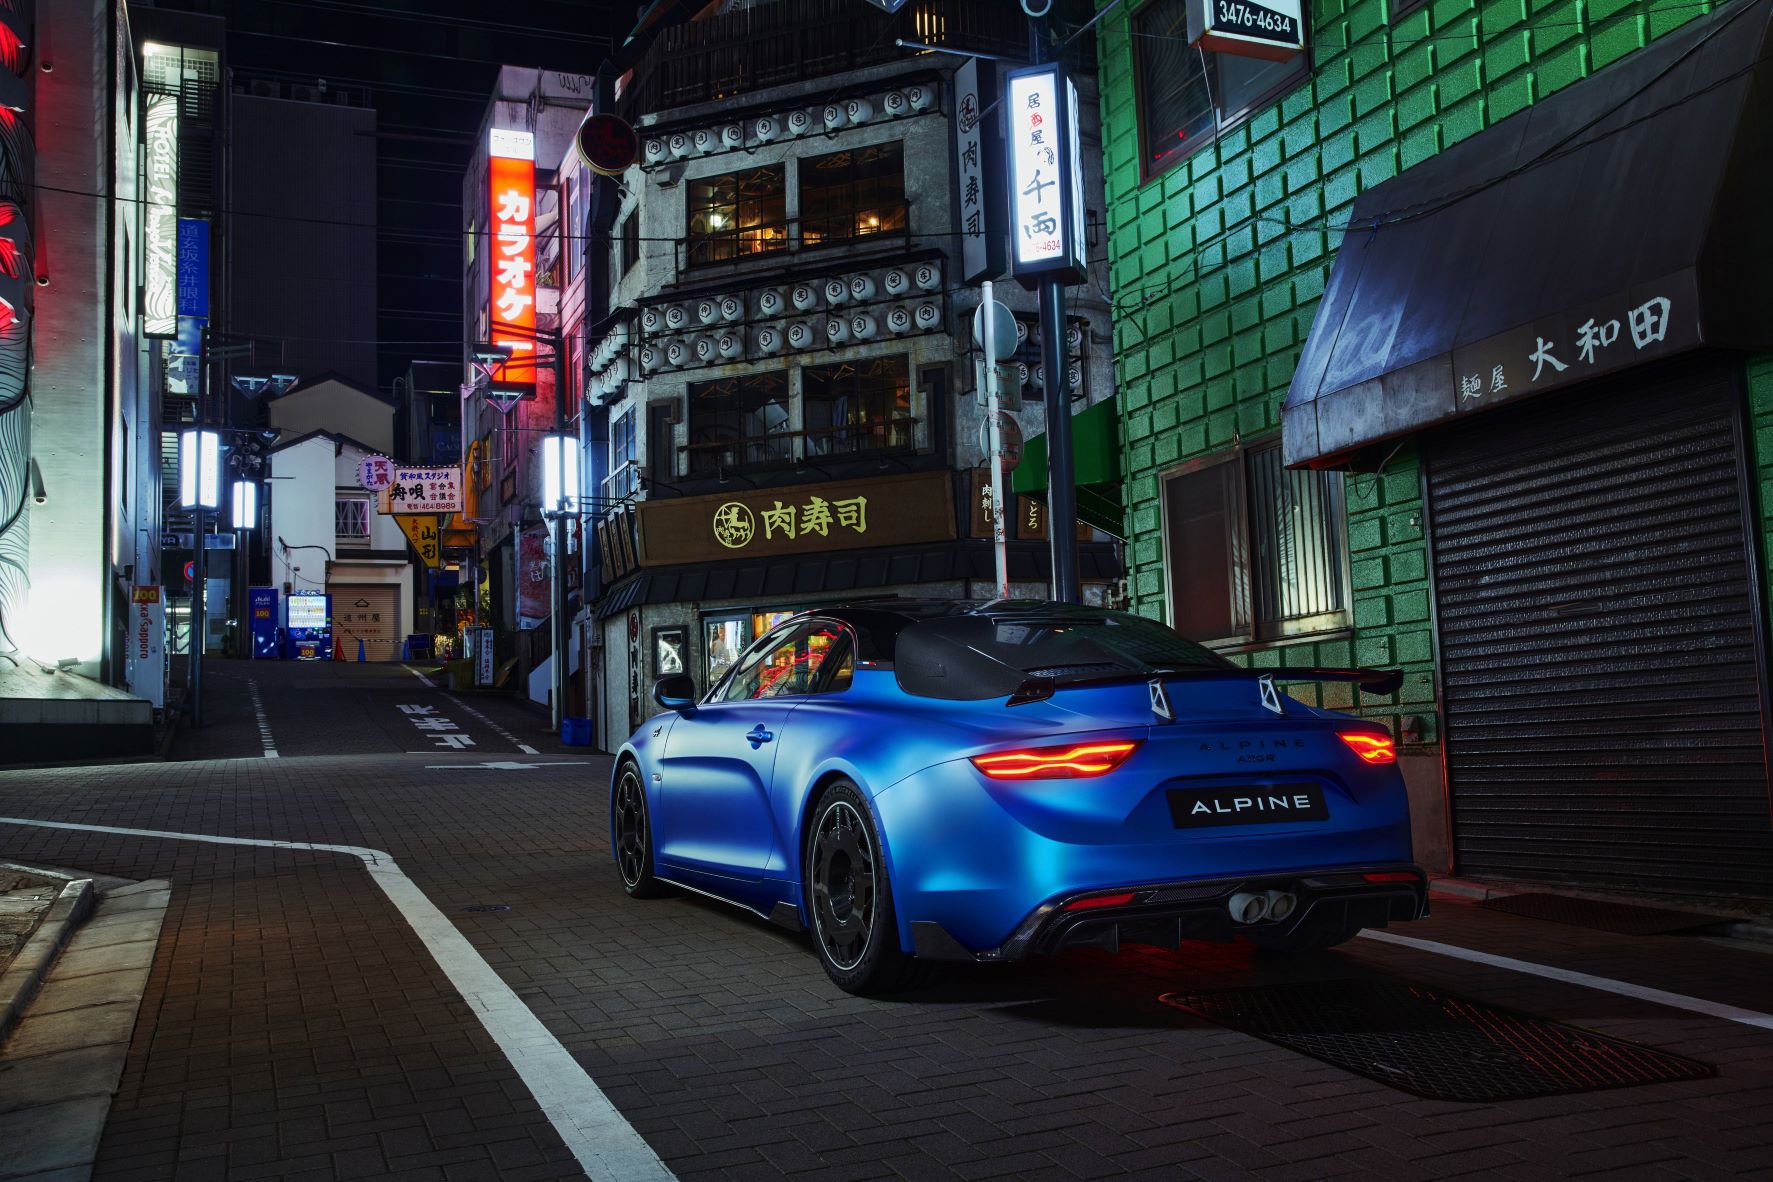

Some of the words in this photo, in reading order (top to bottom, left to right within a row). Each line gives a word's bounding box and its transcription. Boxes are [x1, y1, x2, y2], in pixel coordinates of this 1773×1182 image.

[1219, 1, 1290, 33] 3476-4634
[153, 126, 170, 180] HOTEL
[962, 141, 980, 239] 肉寿司
[180, 224, 200, 312] 道玄坂糸井眼科
[496, 190, 532, 321] カラオケ
[1529, 296, 1671, 382] 大和田
[760, 495, 867, 540] 肉寿司
[1028, 500, 1038, 529] とろ
[133, 590, 156, 600] 100
[256, 609, 270, 618] 100
[1200, 738, 1304, 751] ALPINE
[1191, 794, 1311, 815] ALPINE
